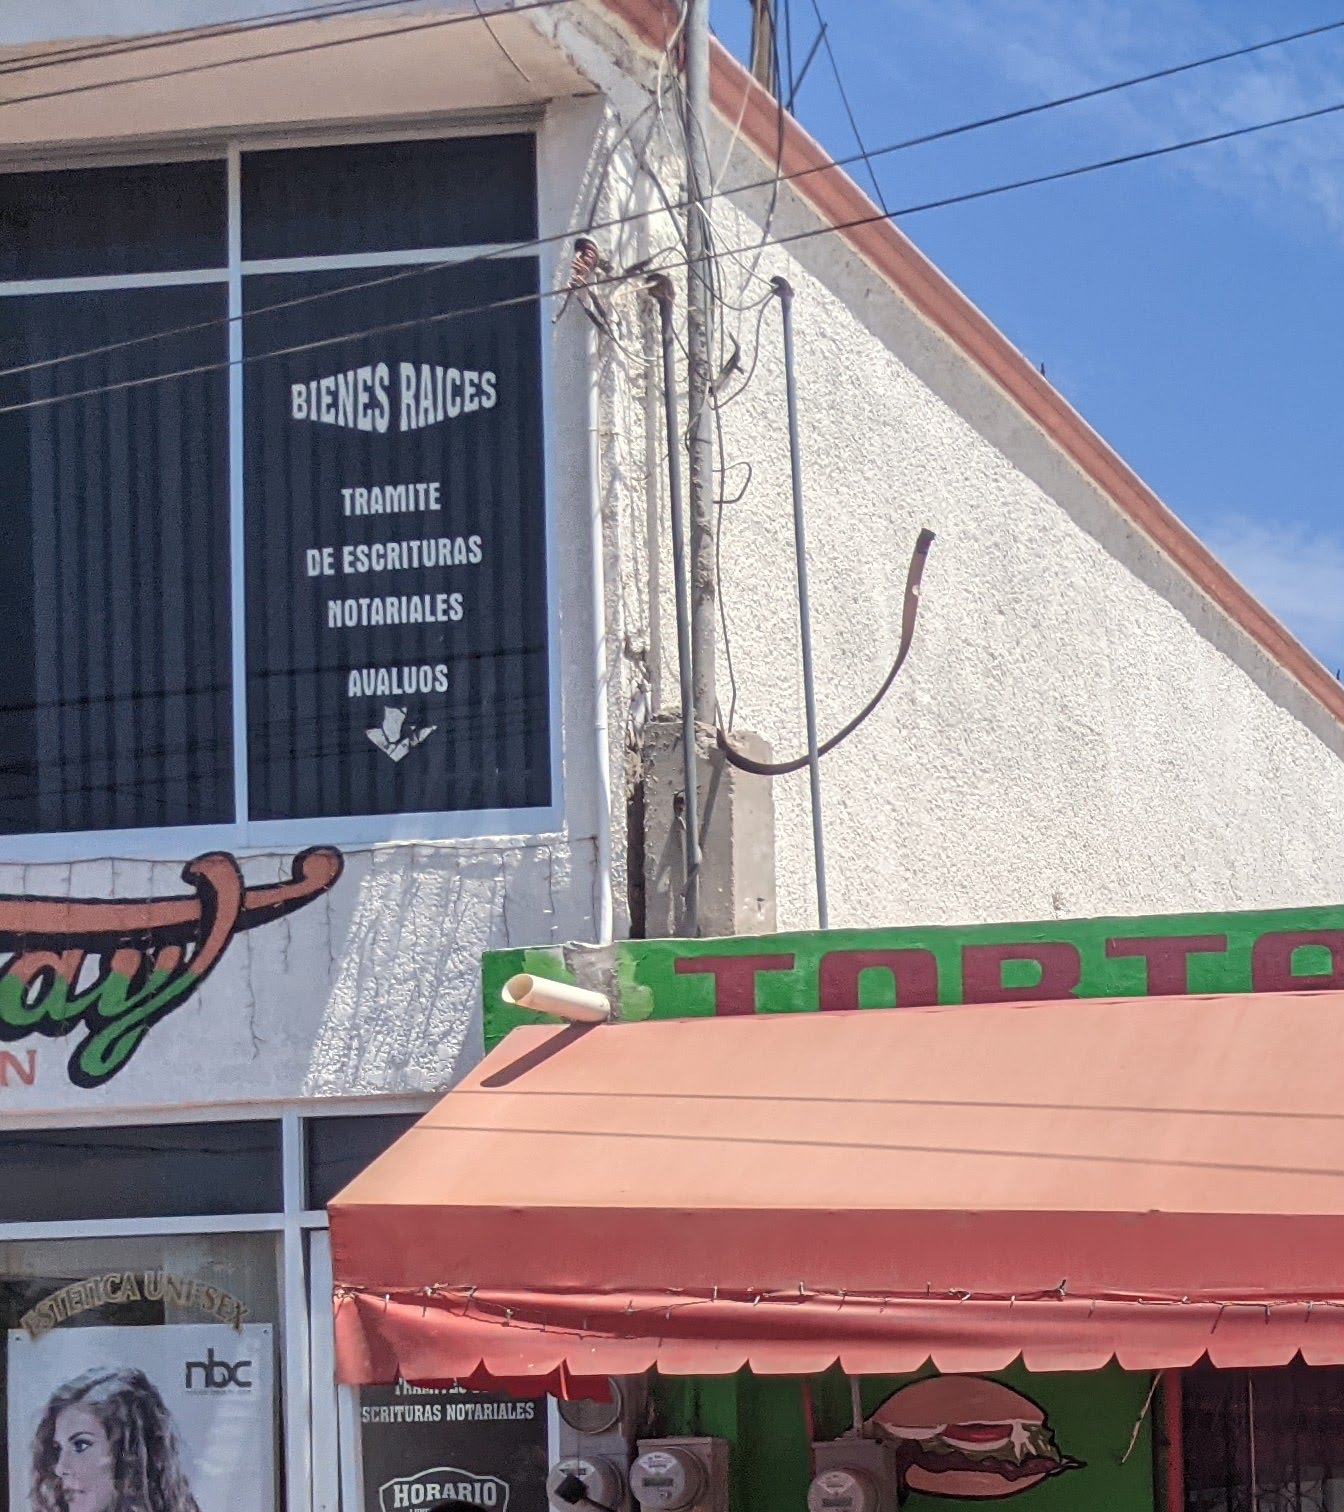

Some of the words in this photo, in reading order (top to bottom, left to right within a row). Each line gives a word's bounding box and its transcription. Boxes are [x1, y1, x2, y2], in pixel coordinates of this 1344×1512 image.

[290, 361, 390, 434] BIENES
[399, 361, 498, 432] RAICES
[340, 482, 442, 517] TRAMITE
[306, 546, 335, 577] DE
[342, 535, 483, 574] ESCRITURAS
[327, 592, 464, 629] NOTARIALES
[347, 664, 449, 698] AVALUOS
[185, 1347, 253, 1389] nbc
[362, 1404, 442, 1423] SCRITURAS
[446, 1402, 535, 1421] NOTARIALES
[393, 1481, 497, 1508] HORARIO
